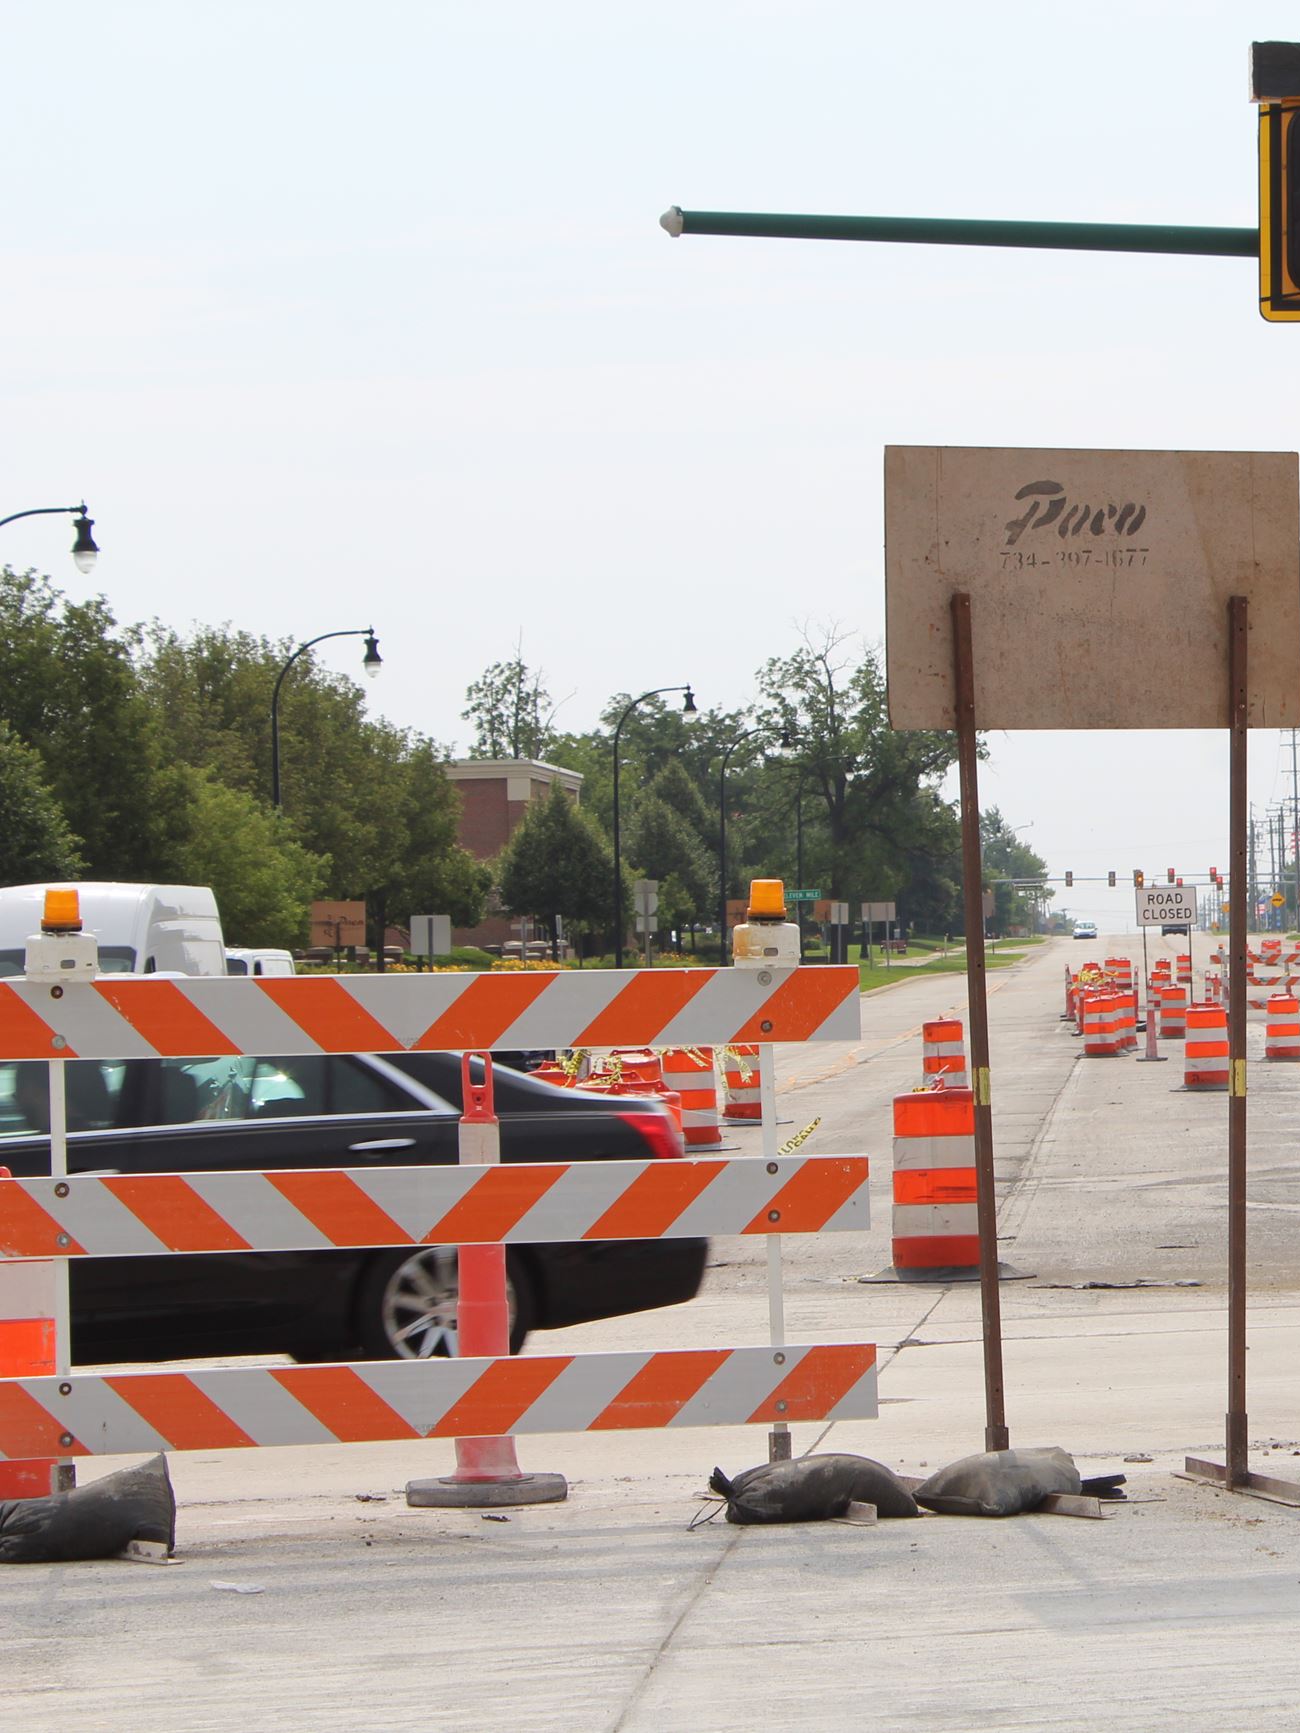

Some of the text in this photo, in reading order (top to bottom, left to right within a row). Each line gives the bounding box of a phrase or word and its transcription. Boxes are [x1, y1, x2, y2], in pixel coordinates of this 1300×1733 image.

[1004, 479, 1147, 546] Poco
[1147, 893, 1183, 905] ROAD
[1142, 907, 1192, 920] CLOSED
